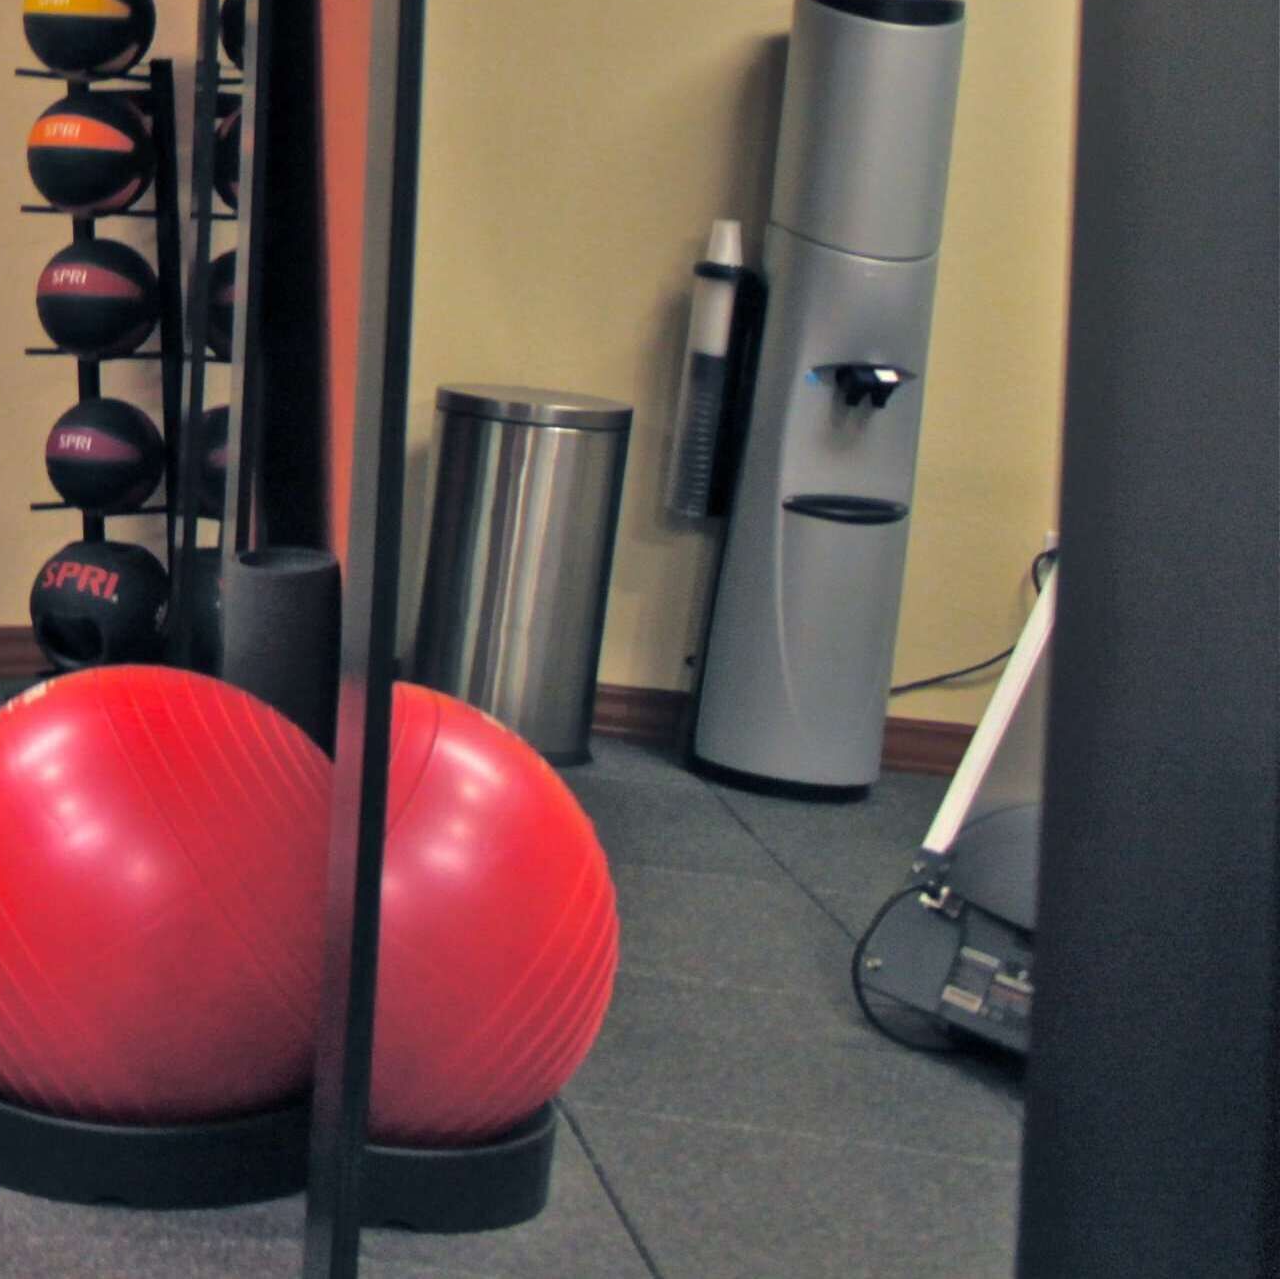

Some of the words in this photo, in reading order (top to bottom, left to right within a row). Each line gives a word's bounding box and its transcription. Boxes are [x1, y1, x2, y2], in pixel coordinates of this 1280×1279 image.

[51, 268, 88, 285] SPRI
[58, 433, 93, 451] SPRI
[41, 561, 119, 599] SPRI
